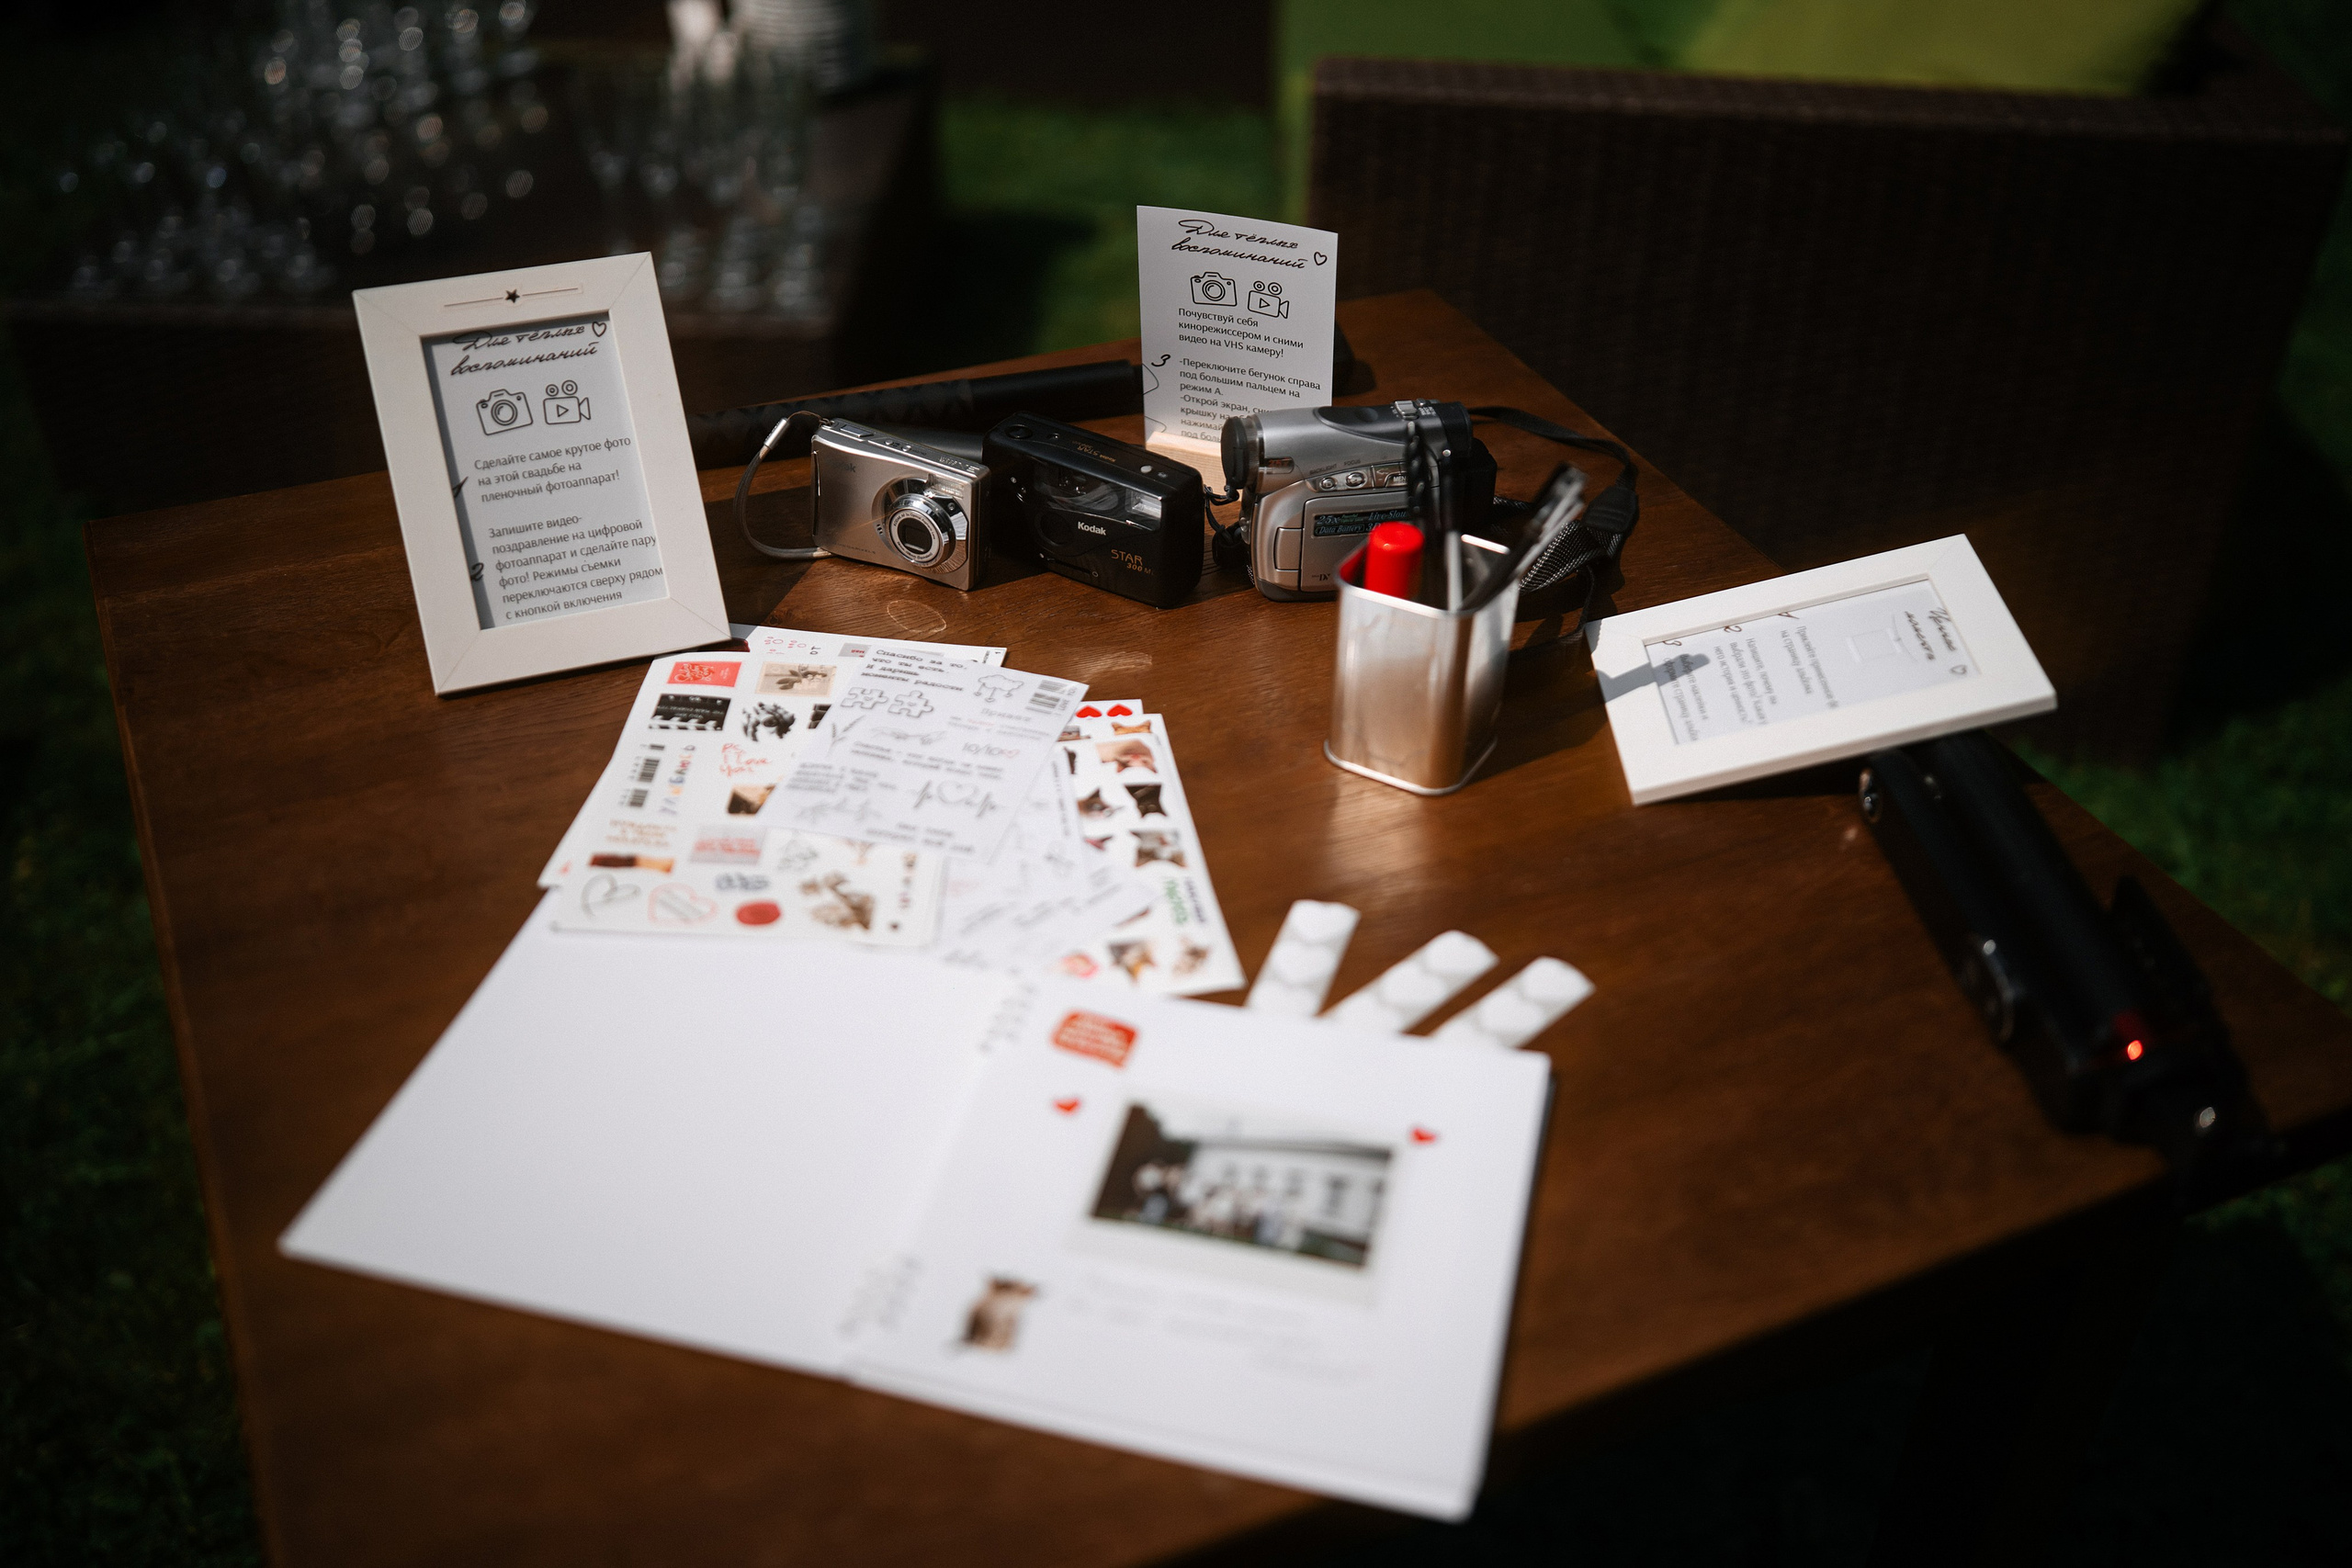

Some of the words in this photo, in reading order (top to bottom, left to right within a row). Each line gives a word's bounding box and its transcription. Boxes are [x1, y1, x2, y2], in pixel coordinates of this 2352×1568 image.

[1178, 219, 1231, 238] Для
[1235, 232, 1298, 249] тёплых
[1171, 236, 1307, 269] воспоминаний
[1178, 308, 1235, 324] Почувствуй
[1237, 318, 1259, 328] себя
[452, 330, 512, 351] Для
[515, 325, 585, 343] тёплых
[1178, 322, 1261, 341] кинорежиссером
[1272, 335, 1304, 349] сними
[1179, 334, 1208, 345] видео
[1210, 339, 1222, 347] на
[1224, 339, 1244, 351] VHS
[1246, 344, 1284, 359] камеру!
[450, 341, 599, 376] воспоминаний
[1151, 354, 1171, 367] 3
[1180, 357, 1247, 376] -Переключите
[1248, 368, 1286, 383] бегунок
[1287, 377, 1321, 390] справа
[1180, 370, 1198, 381] под
[1199, 373, 1244, 387] большим
[1246, 381, 1286, 396] пальцем
[1288, 389, 1301, 398] на
[1180, 382, 1212, 394] режим
[1180, 394, 1218, 407] -Открой
[1220, 400, 1250, 413] экран,
[1181, 407, 1216, 420] крышку
[474, 453, 526, 470] Сделайте
[529, 448, 562, 461] самое
[565, 442, 602, 457] крутое
[604, 436, 631, 452] фото
[478, 476, 492, 487] на
[494, 469, 520, 484] этой
[522, 462, 566, 479] свадьбе
[569, 461, 582, 472] на
[481, 483, 543, 503] пленочный
[545, 469, 620, 495] фотоаппарат!
[489, 521, 544, 538] Запишите
[546, 514, 582, 529] видео-
[1078, 521, 1107, 536] Kodak
[1317, 514, 1340, 525] 25x
[1319, 525, 1336, 535] Data
[1337, 524, 1363, 534] Battery
[492, 534, 570, 555] поздравление
[572, 530, 585, 541] на
[588, 519, 643, 539] цифровой
[495, 549, 567, 573] фотоаппарат
[570, 548, 577, 558] и
[580, 540, 629, 557] сделайте
[631, 535, 657, 547] пару
[1111, 548, 1143, 566] STAR
[499, 571, 530, 590] фото!
[533, 563, 579, 581] Режимы
[1126, 563, 1143, 572] 300
[502, 581, 588, 604] переключаются
[590, 573, 627, 589] сверху
[629, 567, 663, 582] рядом
[505, 611, 513, 620] с
[514, 602, 560, 618] кнопкой
[563, 591, 623, 610] включения
[1781, 629, 1790, 638] на
[1795, 626, 1816, 659] Приклейте
[876, 649, 923, 662] Спасибо
[1713, 645, 1725, 660] него
[1719, 660, 1735, 686] история
[1729, 641, 1747, 669] выбрали
[1741, 669, 1750, 681] это
[1782, 638, 1801, 667] страницу
[861, 671, 911, 682] моменты
[914, 679, 965, 692] радости
[878, 666, 921, 676] даришь
[1759, 671, 1774, 695] почему
[1672, 688, 1690, 719] страницу
[1690, 684, 1707, 715] наклейки
